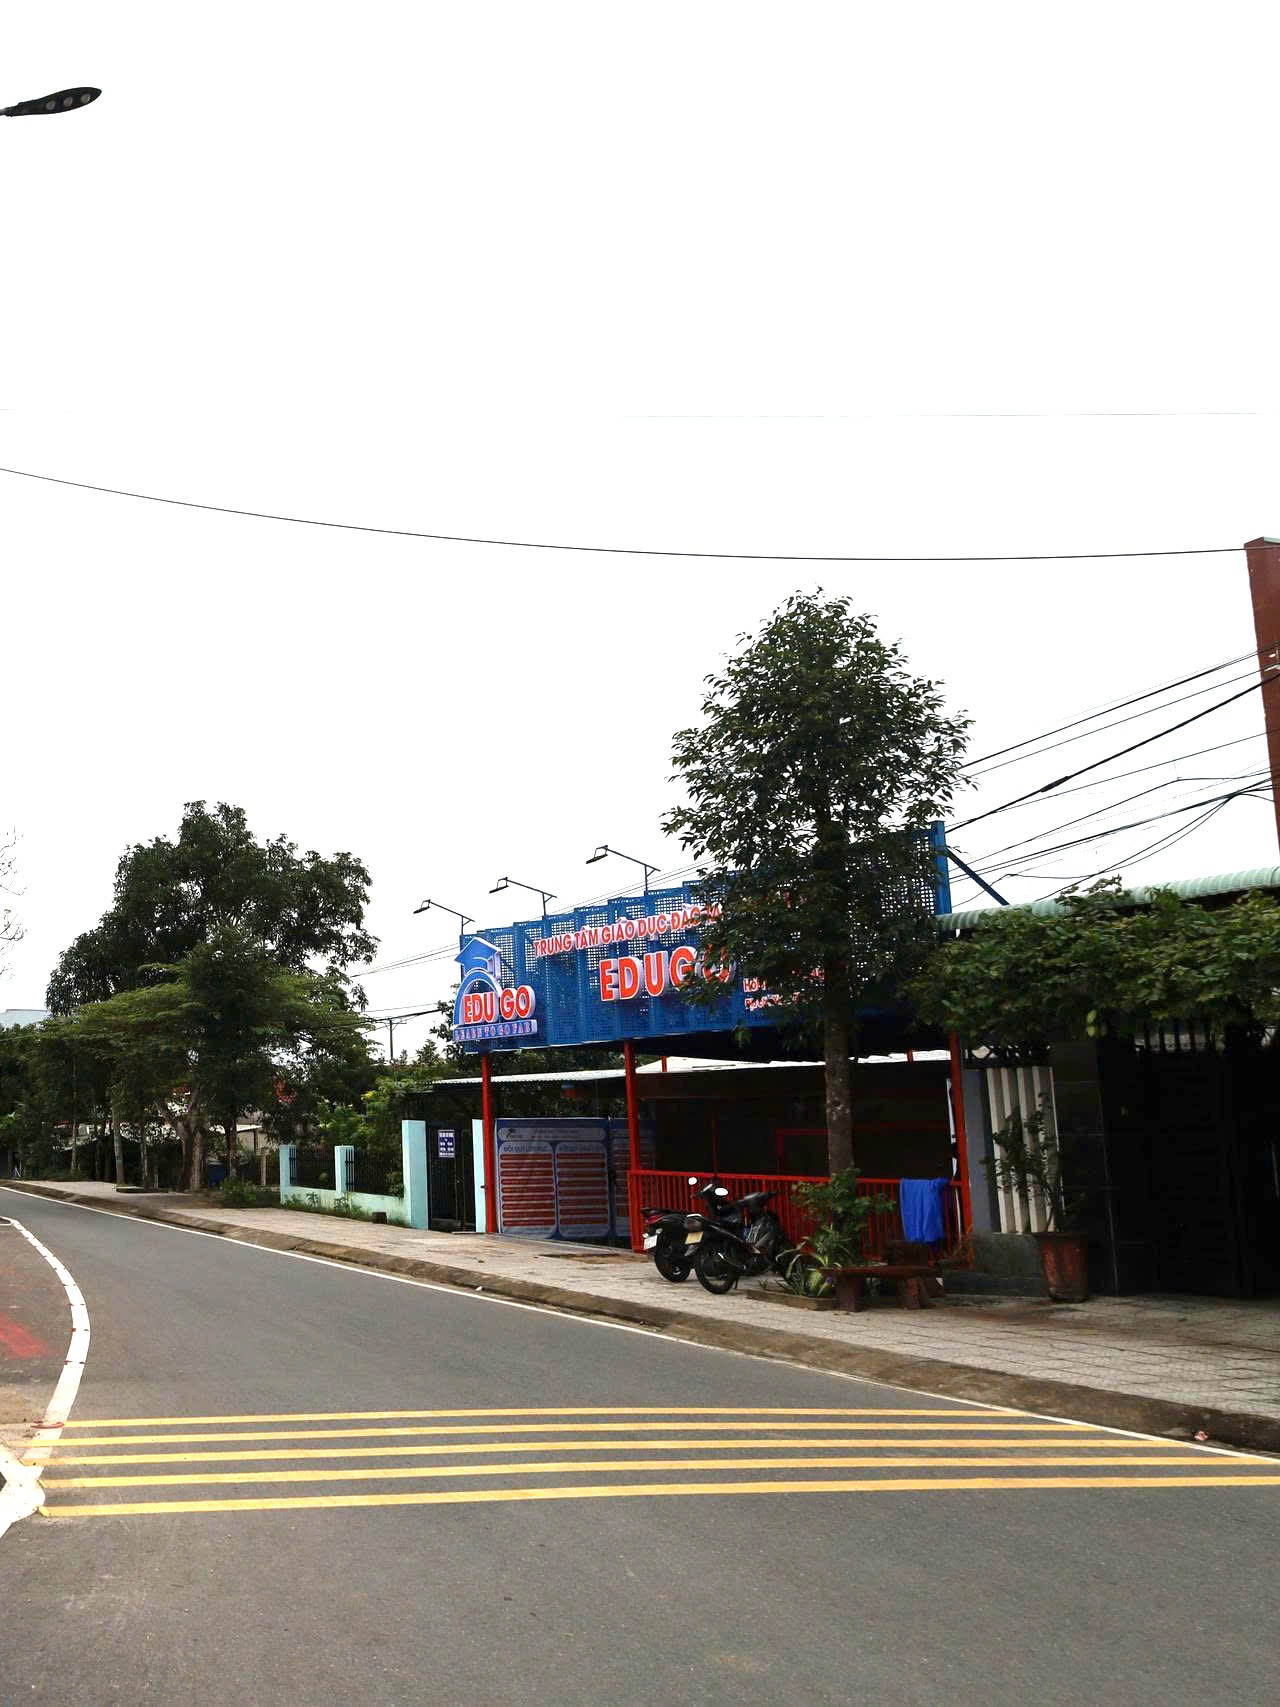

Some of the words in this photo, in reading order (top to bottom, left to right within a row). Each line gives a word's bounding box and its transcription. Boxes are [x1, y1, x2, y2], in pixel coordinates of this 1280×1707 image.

[533, 934, 573, 958] TRUNG
[574, 926, 600, 950] TÂM
[601, 917, 635, 944] GIÁO
[638, 914, 669, 940] DỤC
[454, 1027, 482, 1040] LEARN
[484, 1025, 496, 1037] TO
[511, 1021, 531, 1034] FAR
